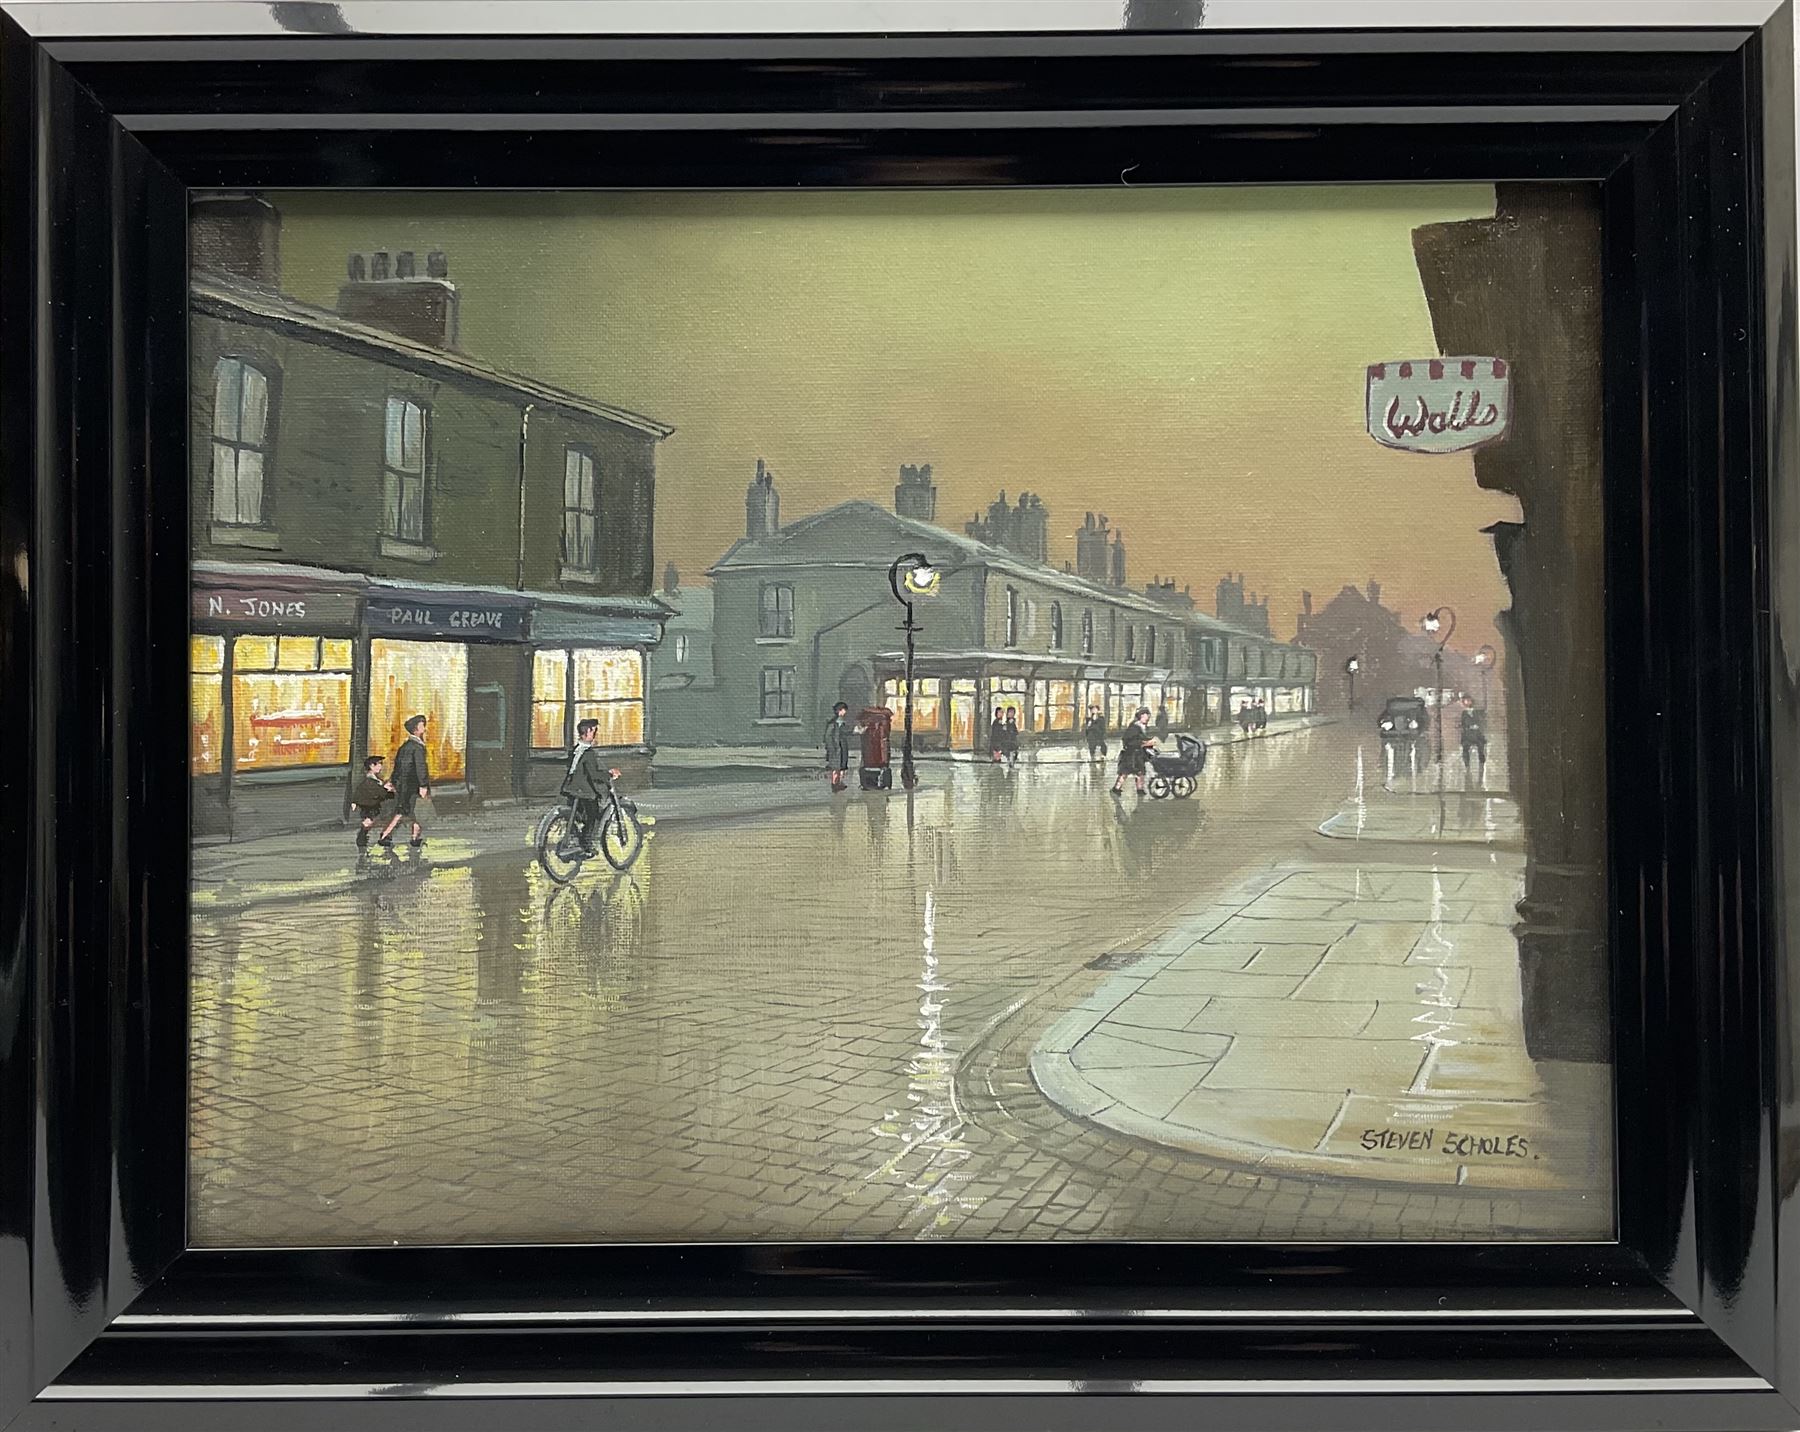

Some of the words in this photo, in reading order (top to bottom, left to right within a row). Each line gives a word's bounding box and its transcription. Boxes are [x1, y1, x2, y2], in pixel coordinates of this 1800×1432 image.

[1383, 390, 1499, 439] Walls
[208, 596, 231, 617] N.
[240, 597, 306, 618] JONES
[390, 607, 434, 626] PAUL
[1360, 1128, 1434, 1151] STEVEN
